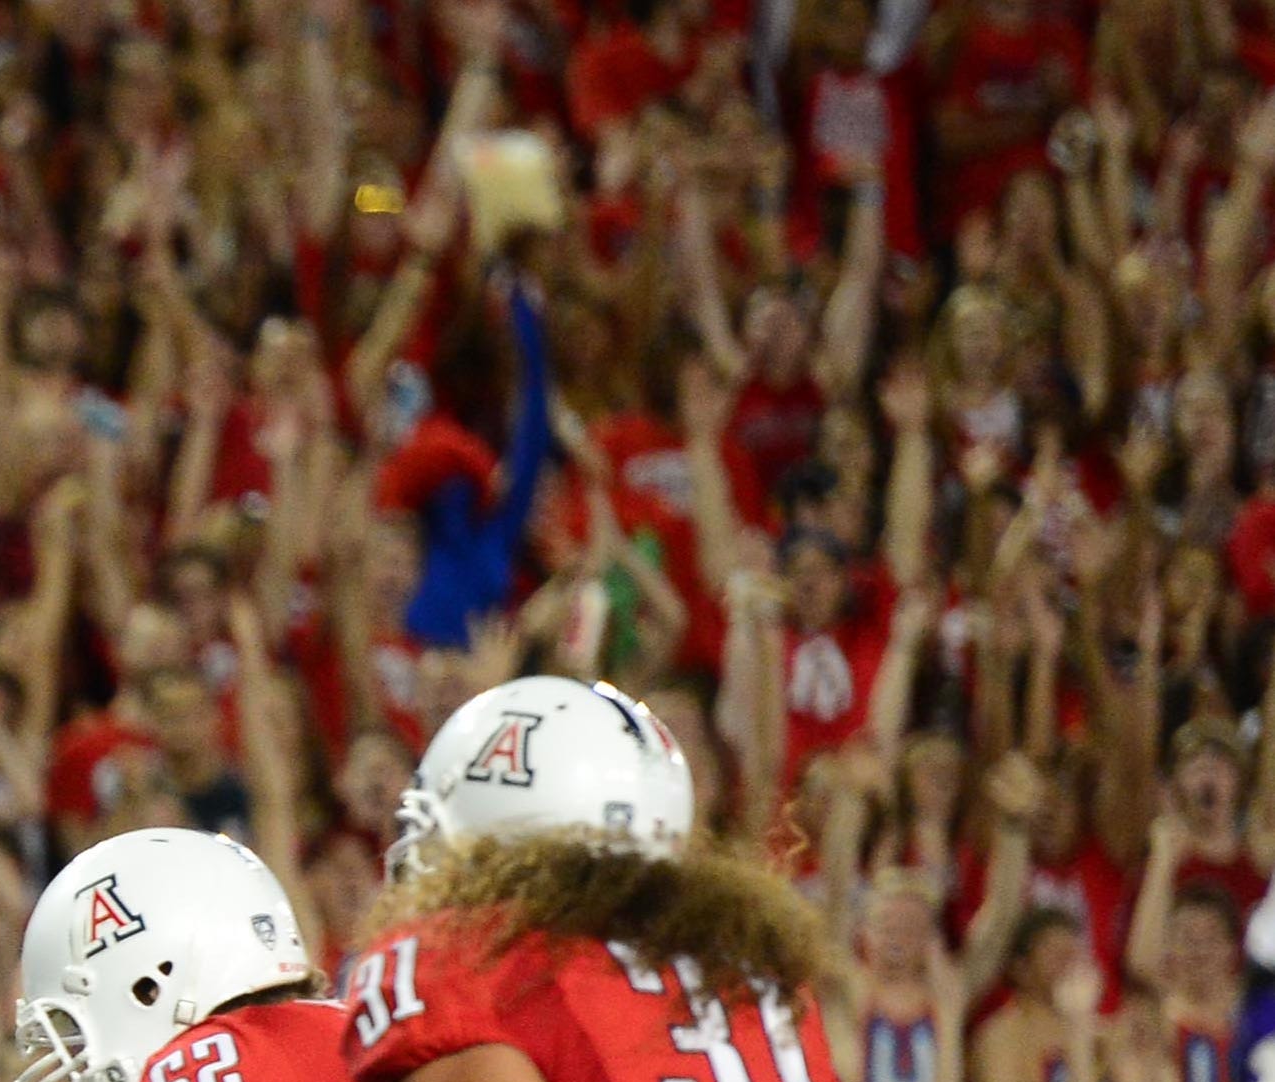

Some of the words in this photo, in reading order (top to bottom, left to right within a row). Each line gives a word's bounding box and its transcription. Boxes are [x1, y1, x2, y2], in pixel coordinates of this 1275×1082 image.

[465, 710, 542, 788] A
[75, 873, 146, 959] A
[354, 936, 426, 1048] 31
